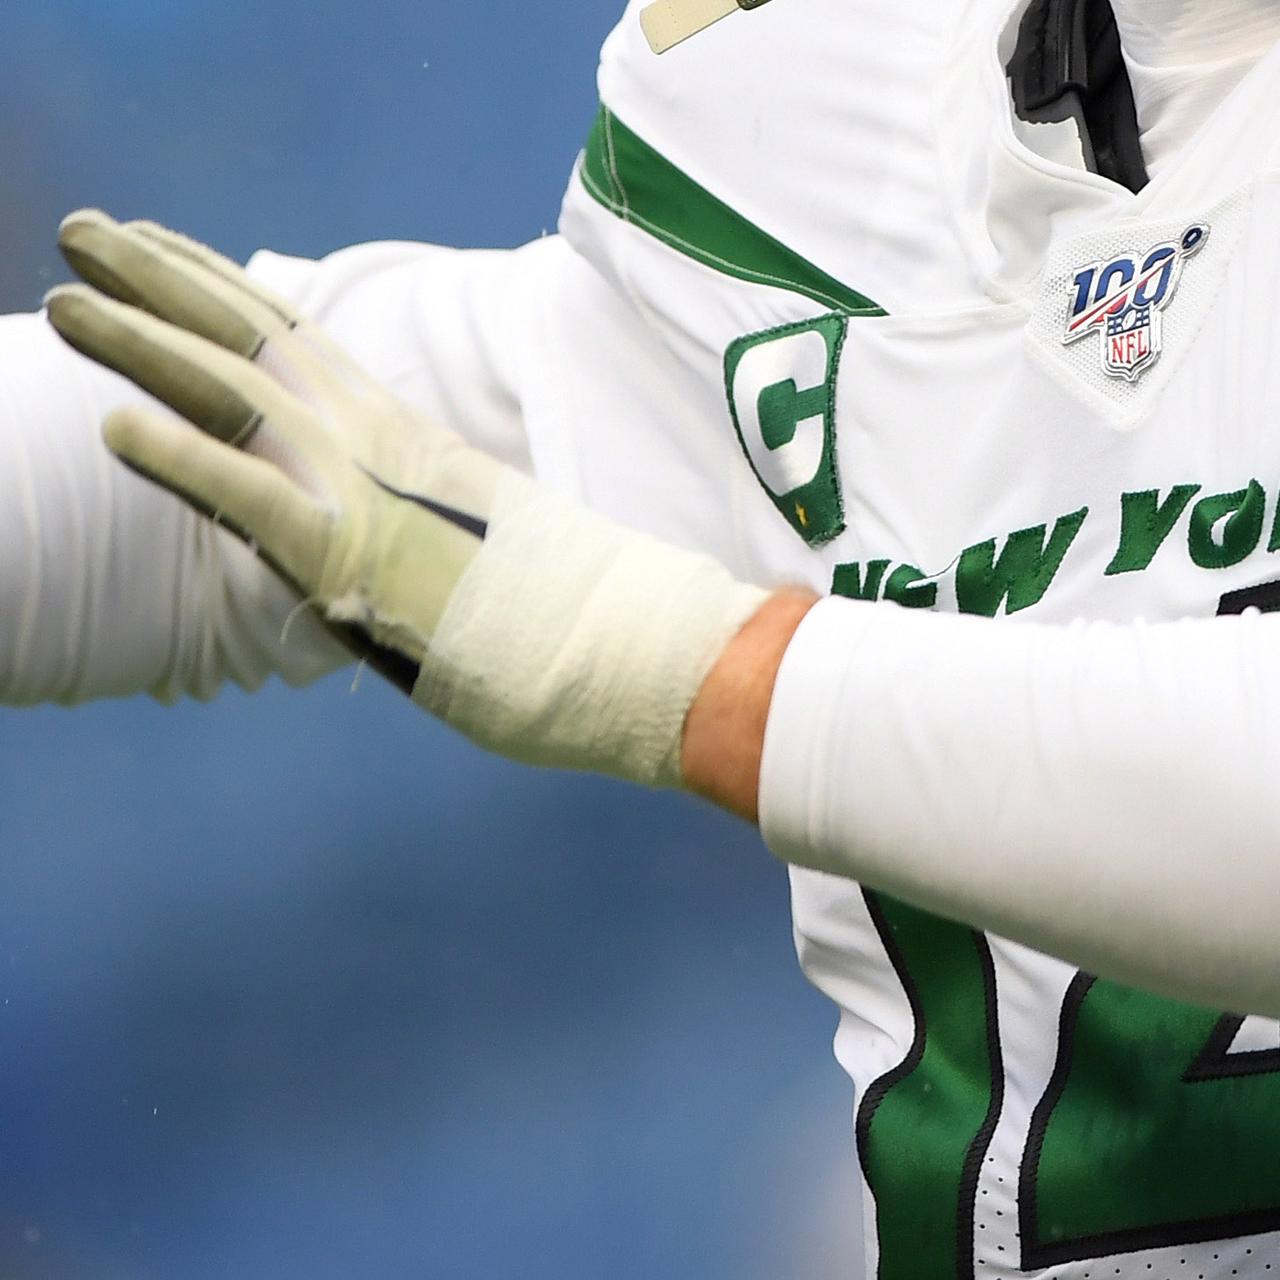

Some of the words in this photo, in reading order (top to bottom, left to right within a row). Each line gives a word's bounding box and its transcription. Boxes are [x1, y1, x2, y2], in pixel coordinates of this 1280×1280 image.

[1072, 246, 1177, 318] 100
[1111, 330, 1148, 364] NFL
[732, 328, 832, 499] C
